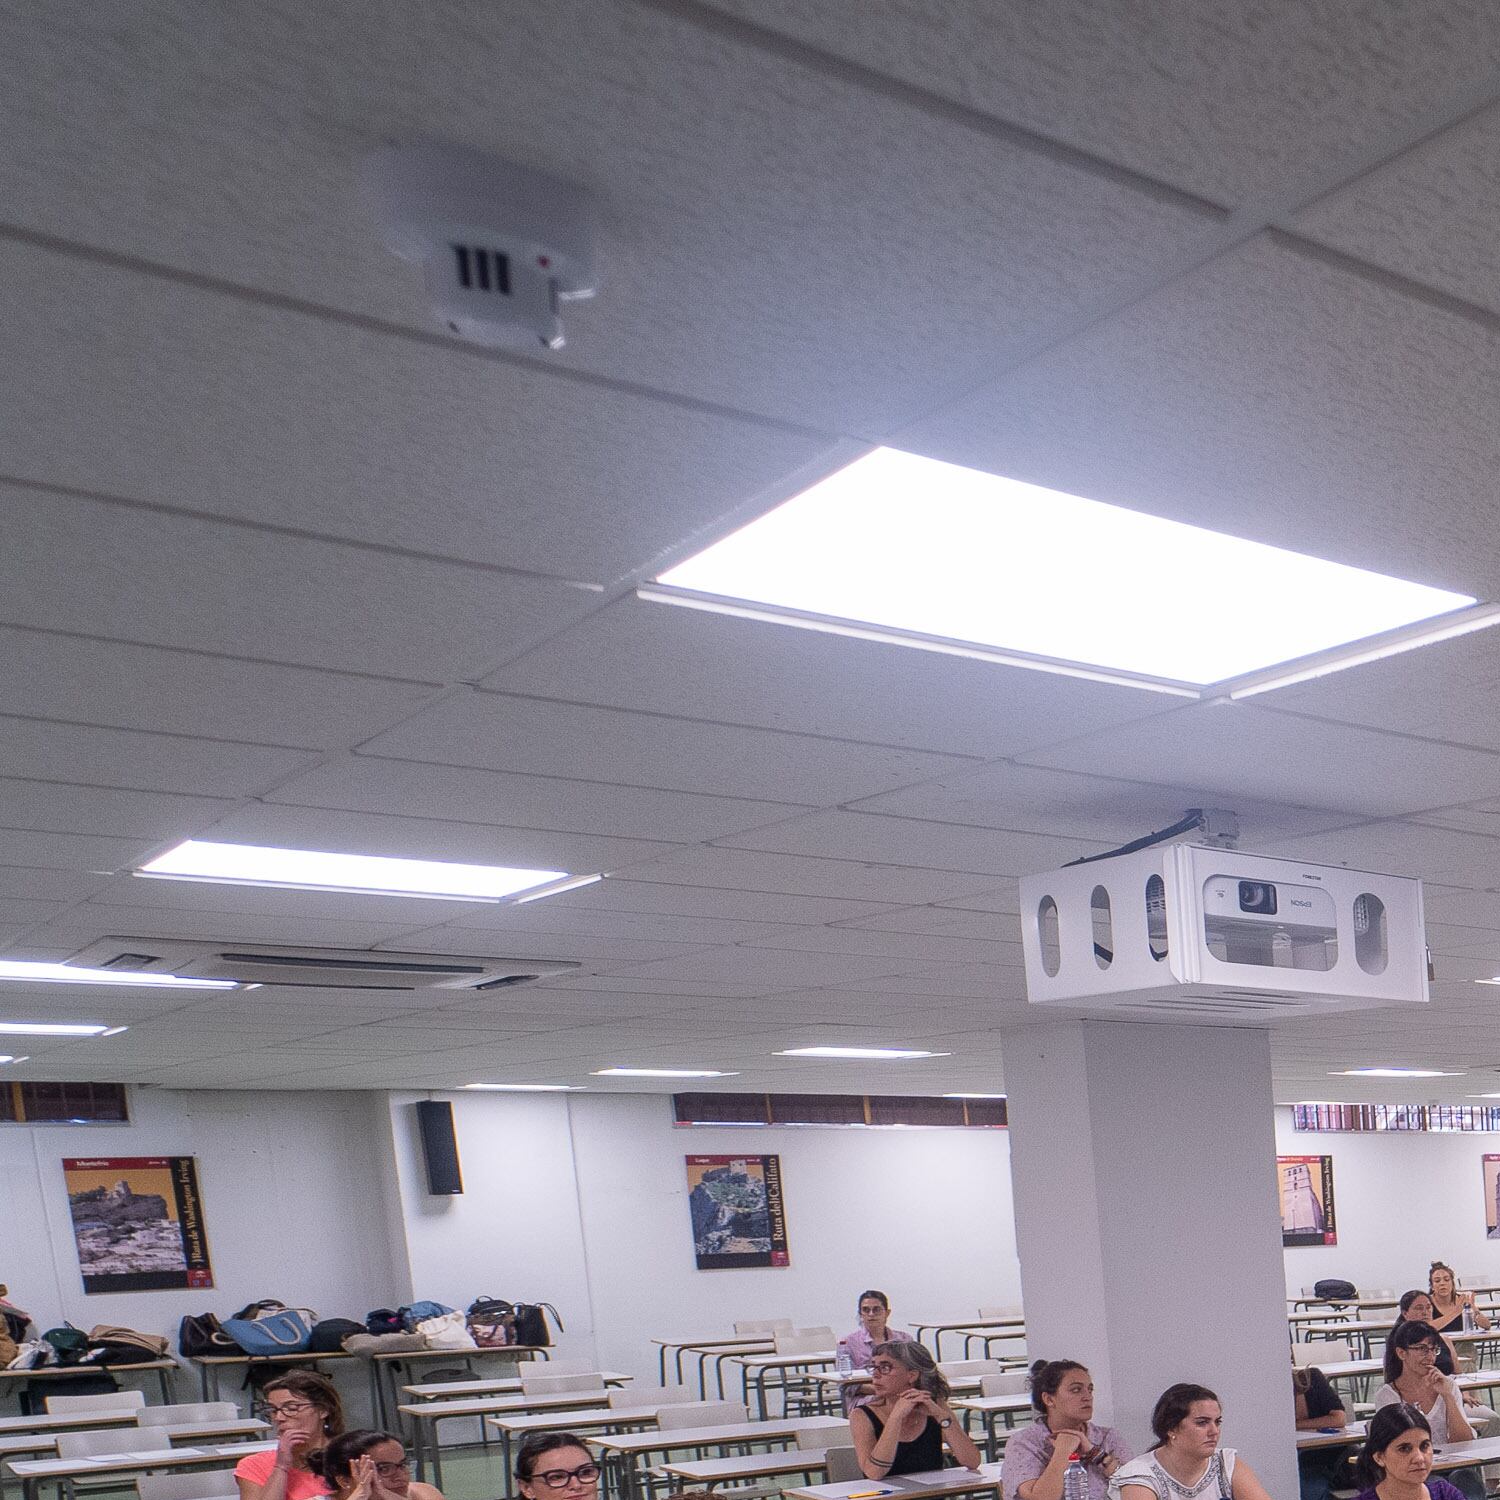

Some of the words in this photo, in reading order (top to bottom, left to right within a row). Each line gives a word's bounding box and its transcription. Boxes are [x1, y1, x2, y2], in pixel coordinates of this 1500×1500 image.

[1290, 899, 1312, 908] EPSON
[178, 1159, 190, 1183] Irving
[766, 1158, 780, 1197] Califato
[183, 1185, 197, 1229] Washington
[769, 1200, 781, 1216] del
[773, 1217, 784, 1241] Ruta
[191, 1241, 202, 1259] Ruta
